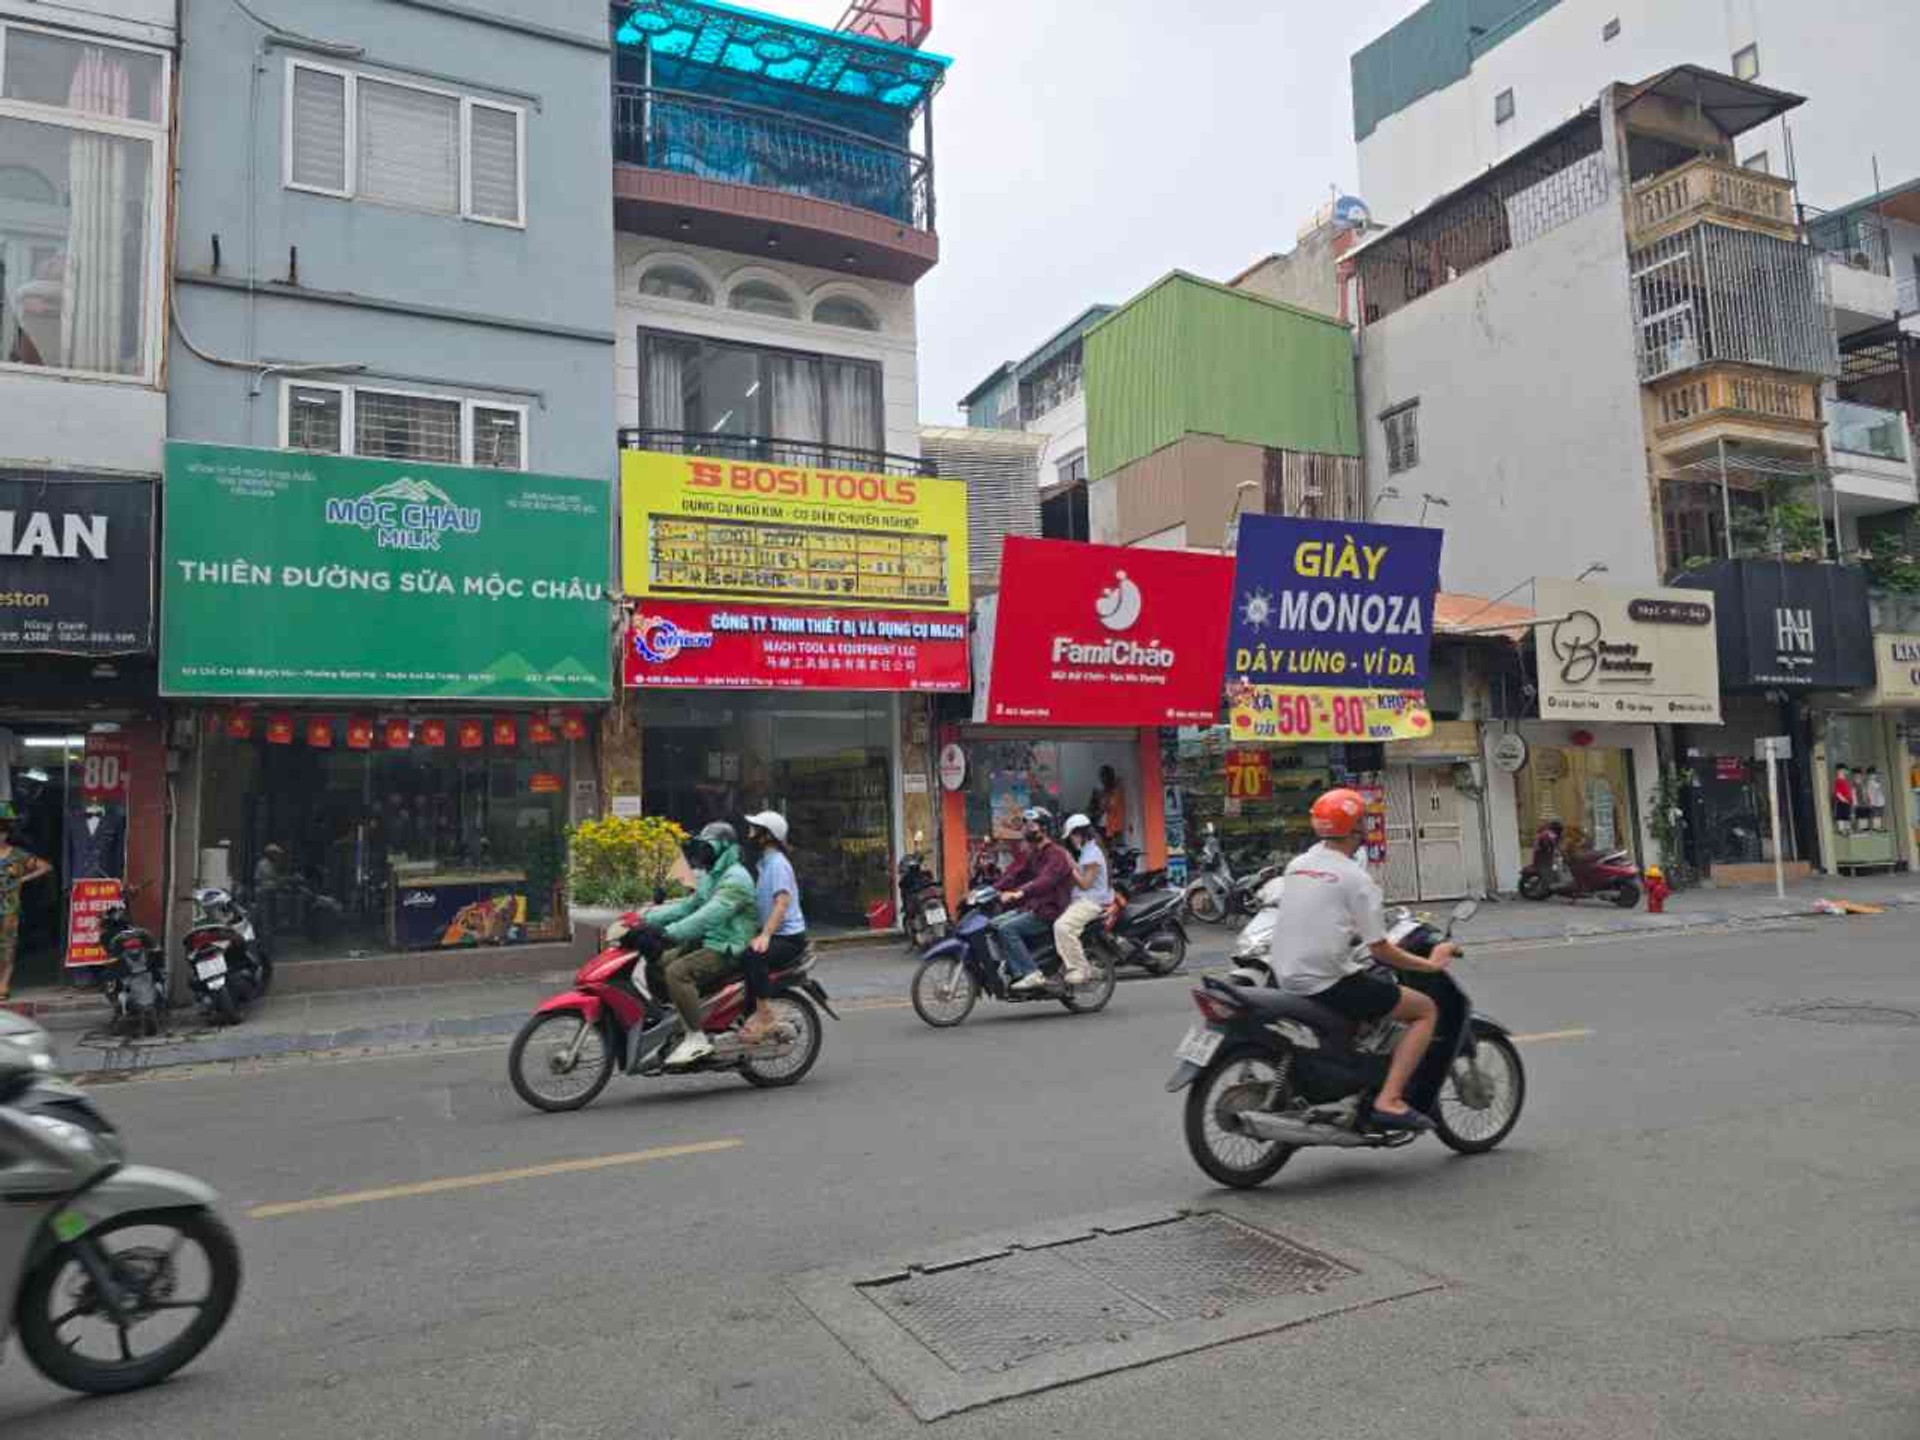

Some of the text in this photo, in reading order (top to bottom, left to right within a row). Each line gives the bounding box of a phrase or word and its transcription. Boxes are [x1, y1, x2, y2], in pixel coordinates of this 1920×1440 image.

[731, 466, 917, 505] BOSI TOOLS
[326, 495, 395, 530] MỘC
[401, 500, 481, 533] CHÂU
[762, 505, 784, 518] KIM
[0, 509, 108, 559] AN
[378, 527, 441, 551] MILK
[1295, 534, 1388, 581] GIÀY
[177, 558, 602, 601] THIÊN ĐƯỜNG SỮA MỘC CHÂU
[710, 613, 964, 640] CÔNG TY TNHH THIẾT BỊ VÀ DỤNG CỤ MACH
[1278, 590, 1424, 636] MONOZA
[1052, 637, 1175, 667] FamiCháo
[1236, 643, 1285, 673] DÂY
[1288, 648, 1346, 675] LƯNG
[1363, 648, 1384, 675] VÍ
[1388, 653, 1416, 676] DA
